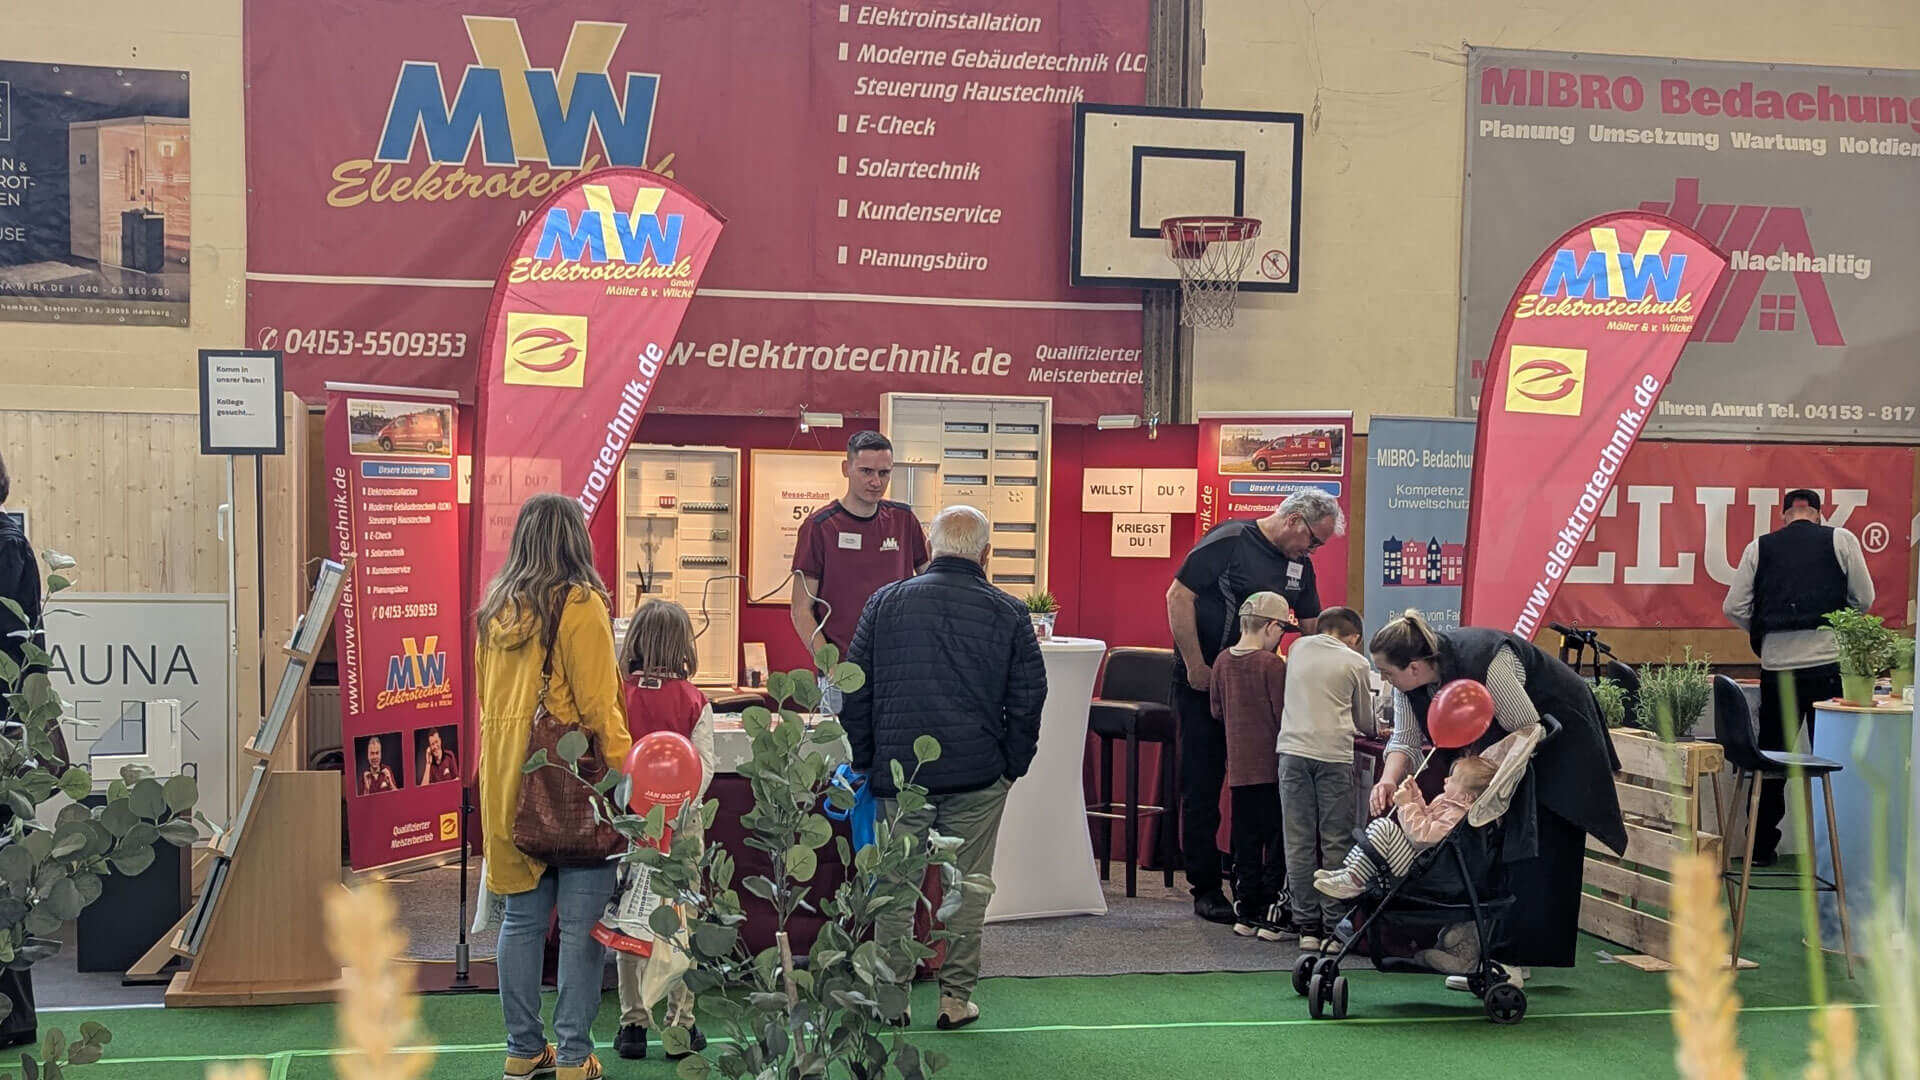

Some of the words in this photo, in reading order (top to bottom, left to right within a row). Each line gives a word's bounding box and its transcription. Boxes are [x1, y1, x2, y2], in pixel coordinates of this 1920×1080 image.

[856, 5, 1042, 33] Elektroinstallation
[856, 43, 946, 67] Moderne
[951, 48, 1109, 73] Gebäudetechnik
[854, 76, 958, 102] Steuerung
[962, 81, 1085, 104] Haustechnik
[1480, 67, 1645, 112] MIBRO
[856, 114, 937, 136] E-Check
[1480, 120, 1576, 146] Planung
[1588, 125, 1720, 151] Umsetzung
[1731, 132, 1827, 156] Wartung
[856, 157, 981, 181] Solartechnik
[857, 200, 1002, 224] Kundenservice
[534, 184, 684, 266] MVW
[508, 256, 692, 284] Elektrotechnik
[859, 248, 988, 272] Planungsbüro
[1540, 228, 1687, 303] MVW
[1730, 250, 1872, 279] Nachhaltig
[606, 286, 640, 296] Möller
[641, 287, 648, 296] &
[663, 288, 694, 298] Wilcke
[1515, 293, 1692, 319] Elektrotechnik
[1606, 321, 1640, 331] Möller
[1641, 323, 1648, 332] &
[1662, 323, 1693, 333] Wilcke
[285, 328, 467, 358] 04153-5509353
[1035, 344, 1142, 362] Qualifizierter
[1658, 401, 1707, 417] Ihren
[1711, 402, 1763, 418] Anruf
[1768, 403, 1800, 419] Tel.
[1804, 404, 1863, 420] 04153
[1880, 406, 1916, 421] 817
[1377, 448, 1420, 468] MIBRO-
[1422, 449, 1473, 469] Bedachu
[781, 491, 830, 499] Messe-Rabatt
[1090, 485, 1134, 495] WILLST
[1157, 485, 1174, 496] DU
[1249, 484, 1275, 492] Unsere
[1396, 484, 1465, 501] Kompetenz
[1116, 523, 1166, 534] KRIEGST
[1129, 536, 1145, 547] DU
[386, 635, 446, 693] MVW
